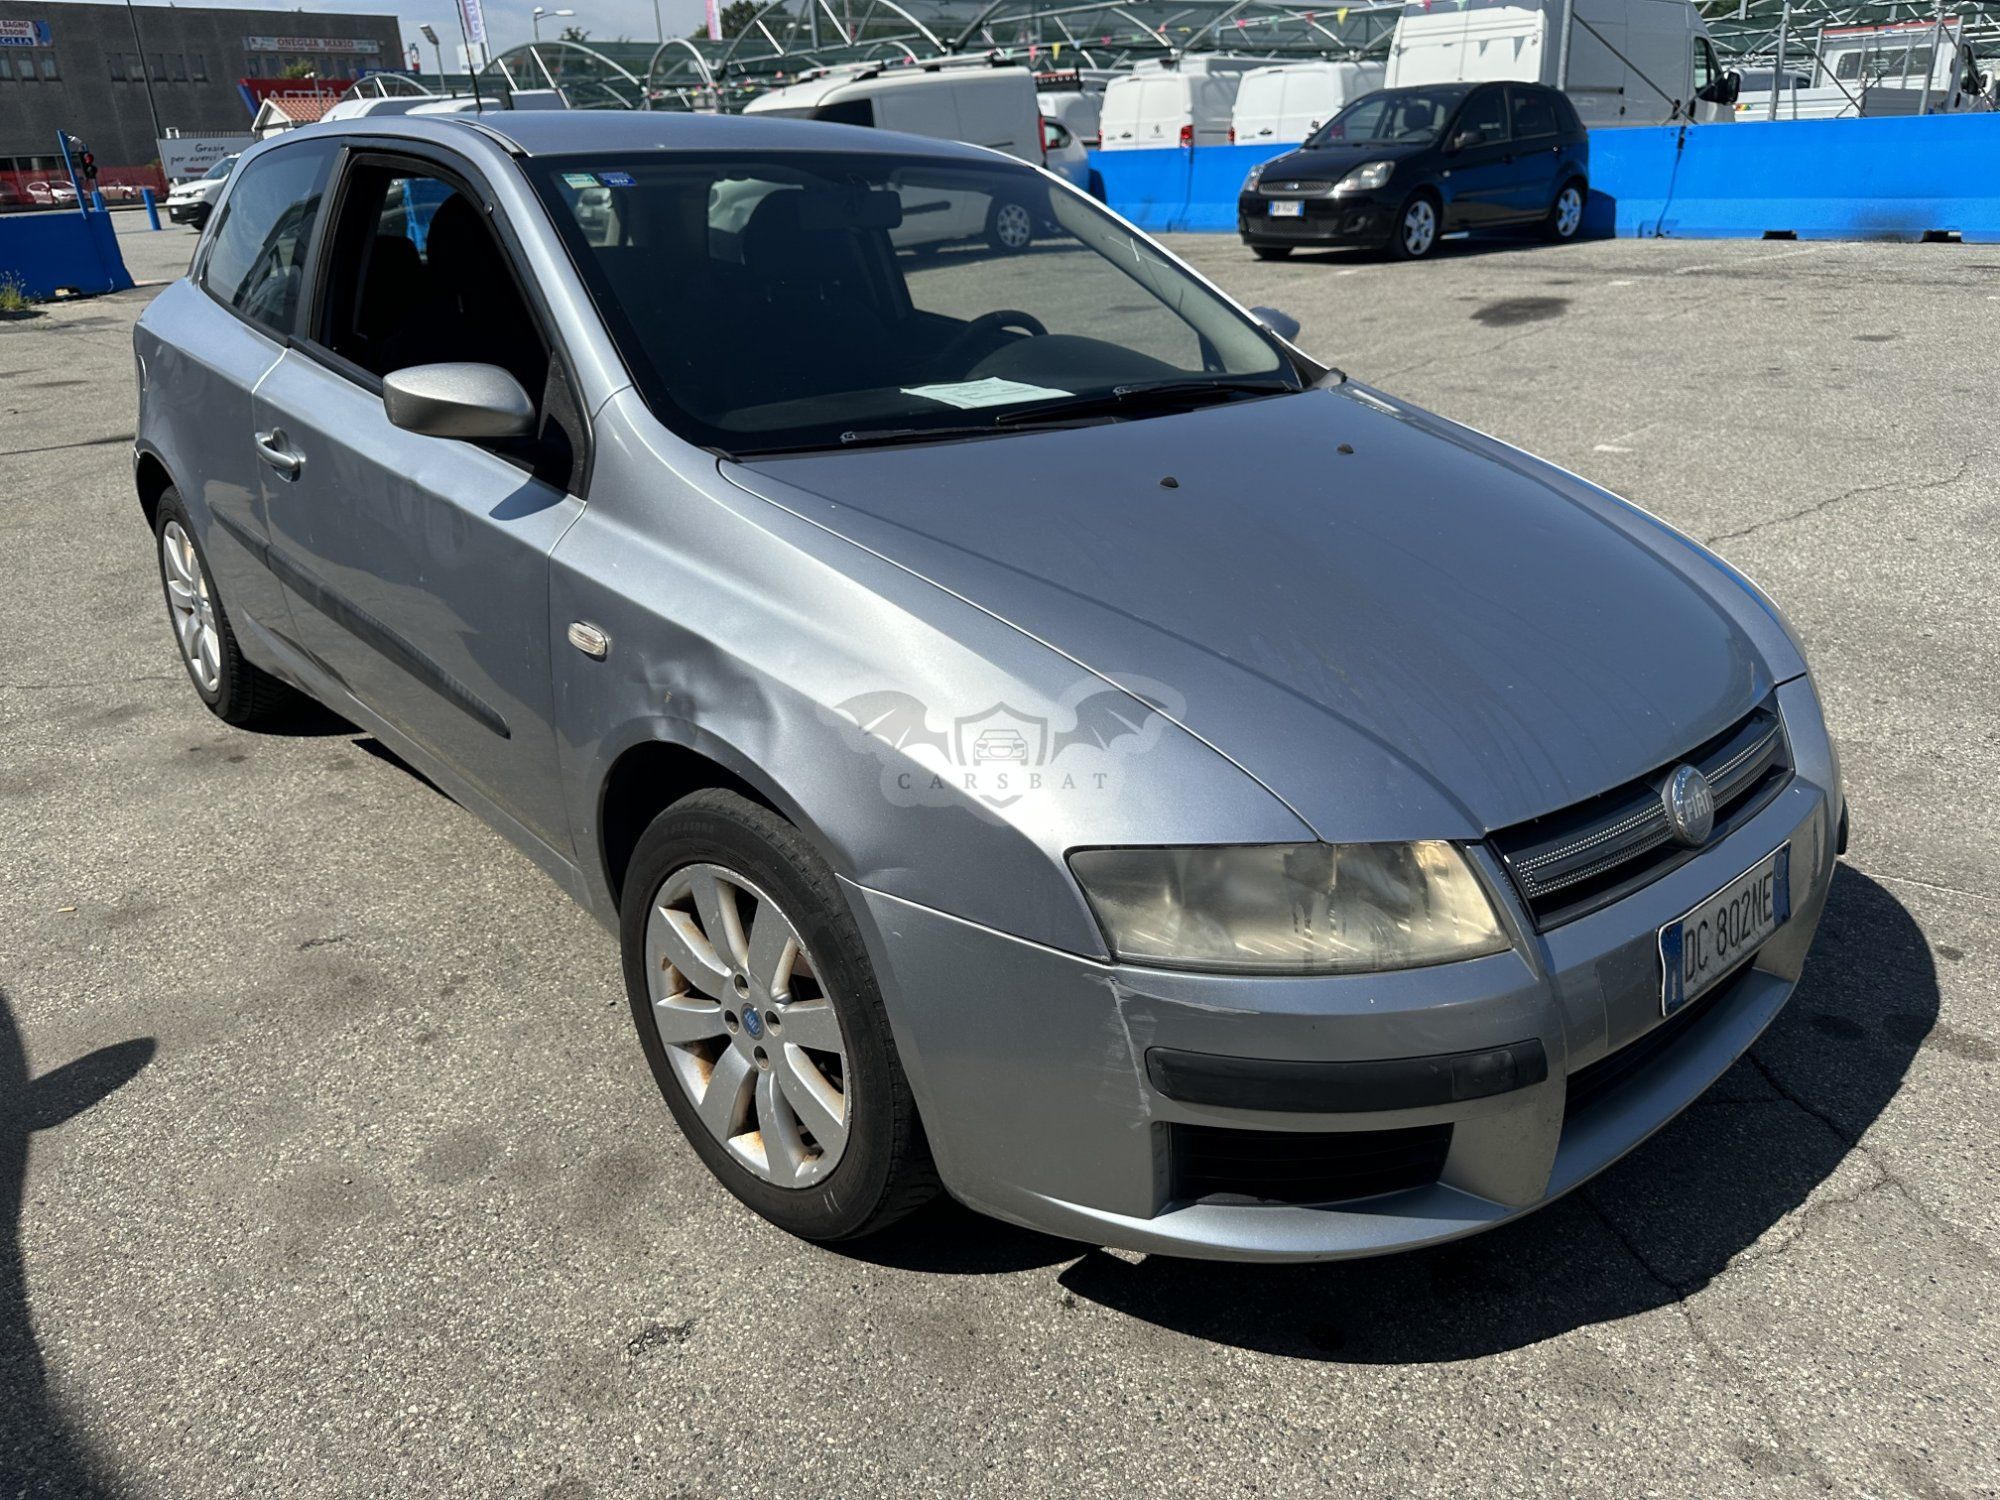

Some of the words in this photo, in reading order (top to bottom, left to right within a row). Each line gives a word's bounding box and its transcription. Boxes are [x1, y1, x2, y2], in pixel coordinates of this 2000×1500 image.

[277, 38, 319, 48] ONEGLIA
[195, 143, 225, 152] Grazie
[171, 156, 185, 166] per
[1684, 788, 1710, 823] FIAT
[1683, 919, 1709, 982] DC
[1716, 872, 1773, 956] 802NE
